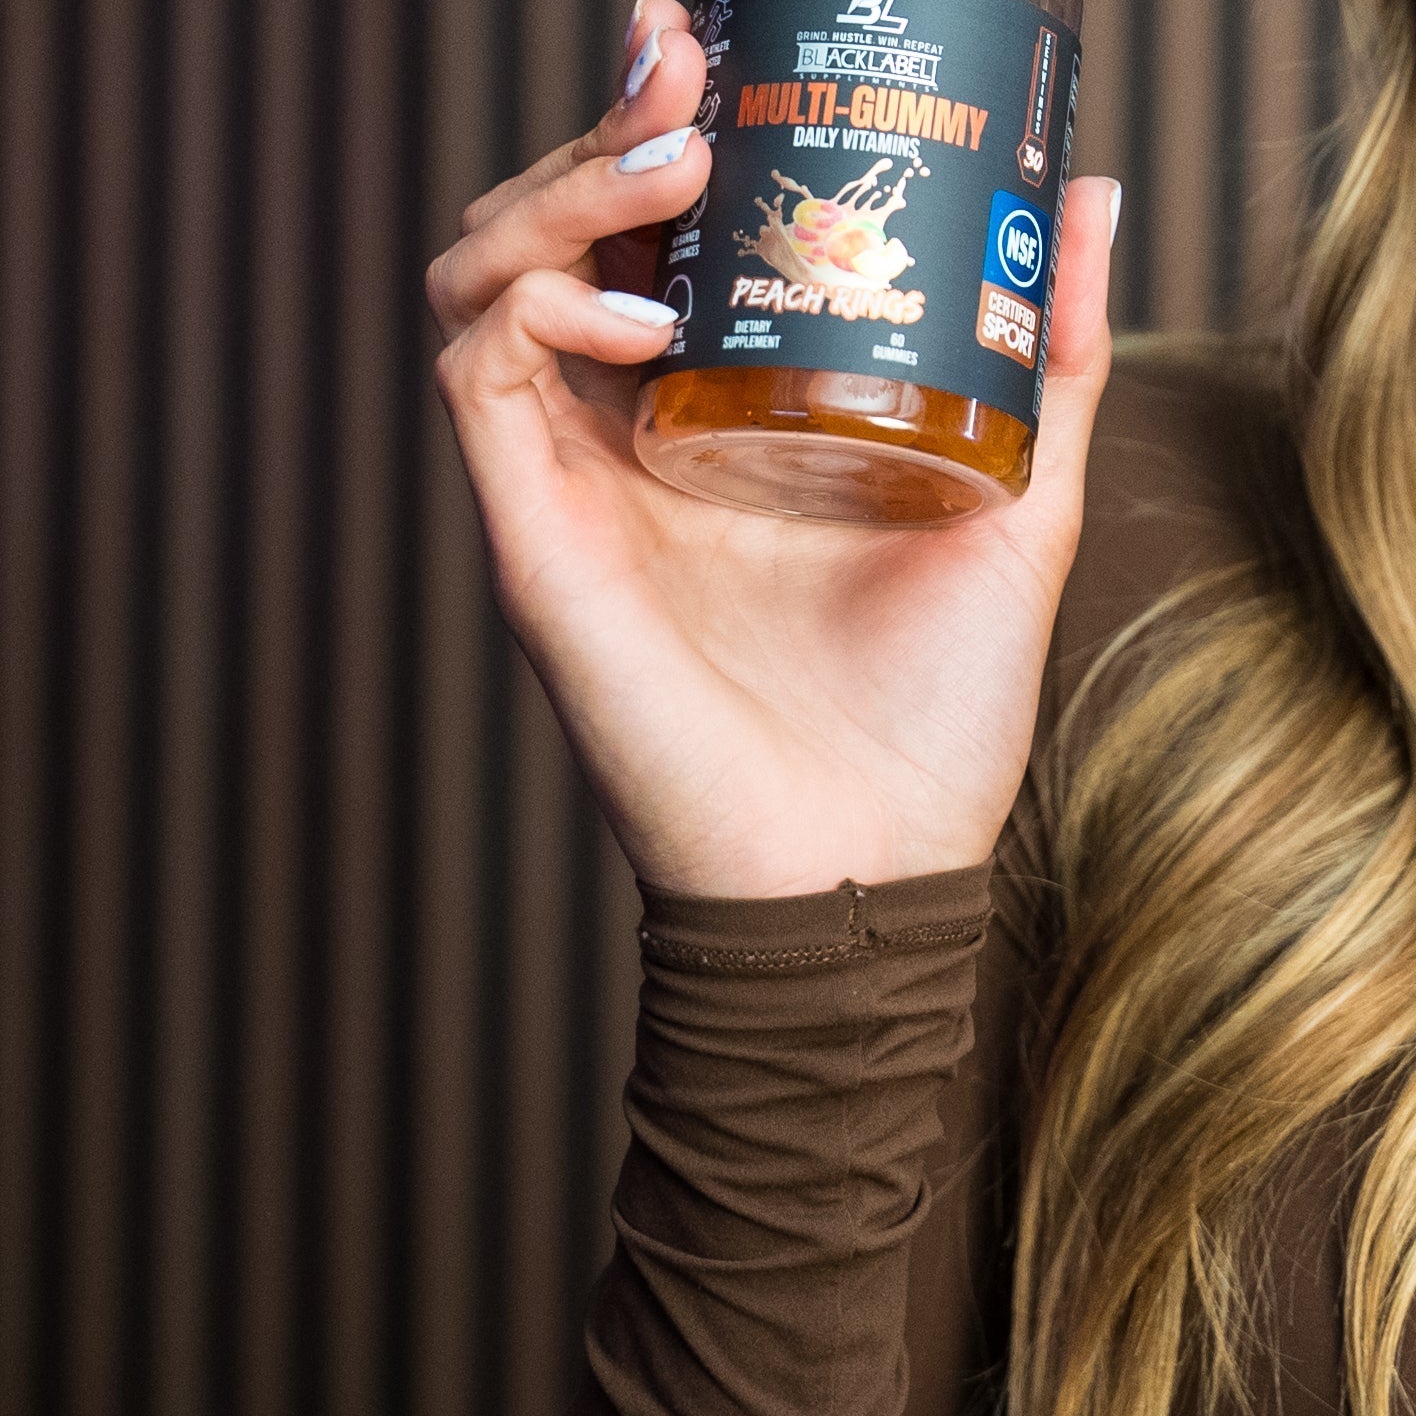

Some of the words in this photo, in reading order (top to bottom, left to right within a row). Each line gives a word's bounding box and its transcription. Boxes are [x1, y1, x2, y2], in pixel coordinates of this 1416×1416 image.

[903, 39, 944, 55] REPEAT
[802, 48, 932, 80] BLACKLABEL
[799, 73, 929, 92] SUPPLEMENTS
[1034, 34, 1051, 134] SERVINGS
[737, 83, 988, 151] MULTI-GUMMY
[793, 126, 841, 148] DAILY
[842, 129, 921, 159] VITAMINS
[1023, 144, 1044, 173] 30
[730, 276, 826, 314] PEACH
[829, 286, 926, 324] RINGS
[988, 291, 1036, 332] CERTIFIED
[722, 335, 781, 349] SUPPLEMENT
[734, 320, 772, 334] DIETARY
[890, 332, 905, 348] 60
[982, 312, 1035, 359] SPORT
[872, 344, 918, 366] GUMMIES
